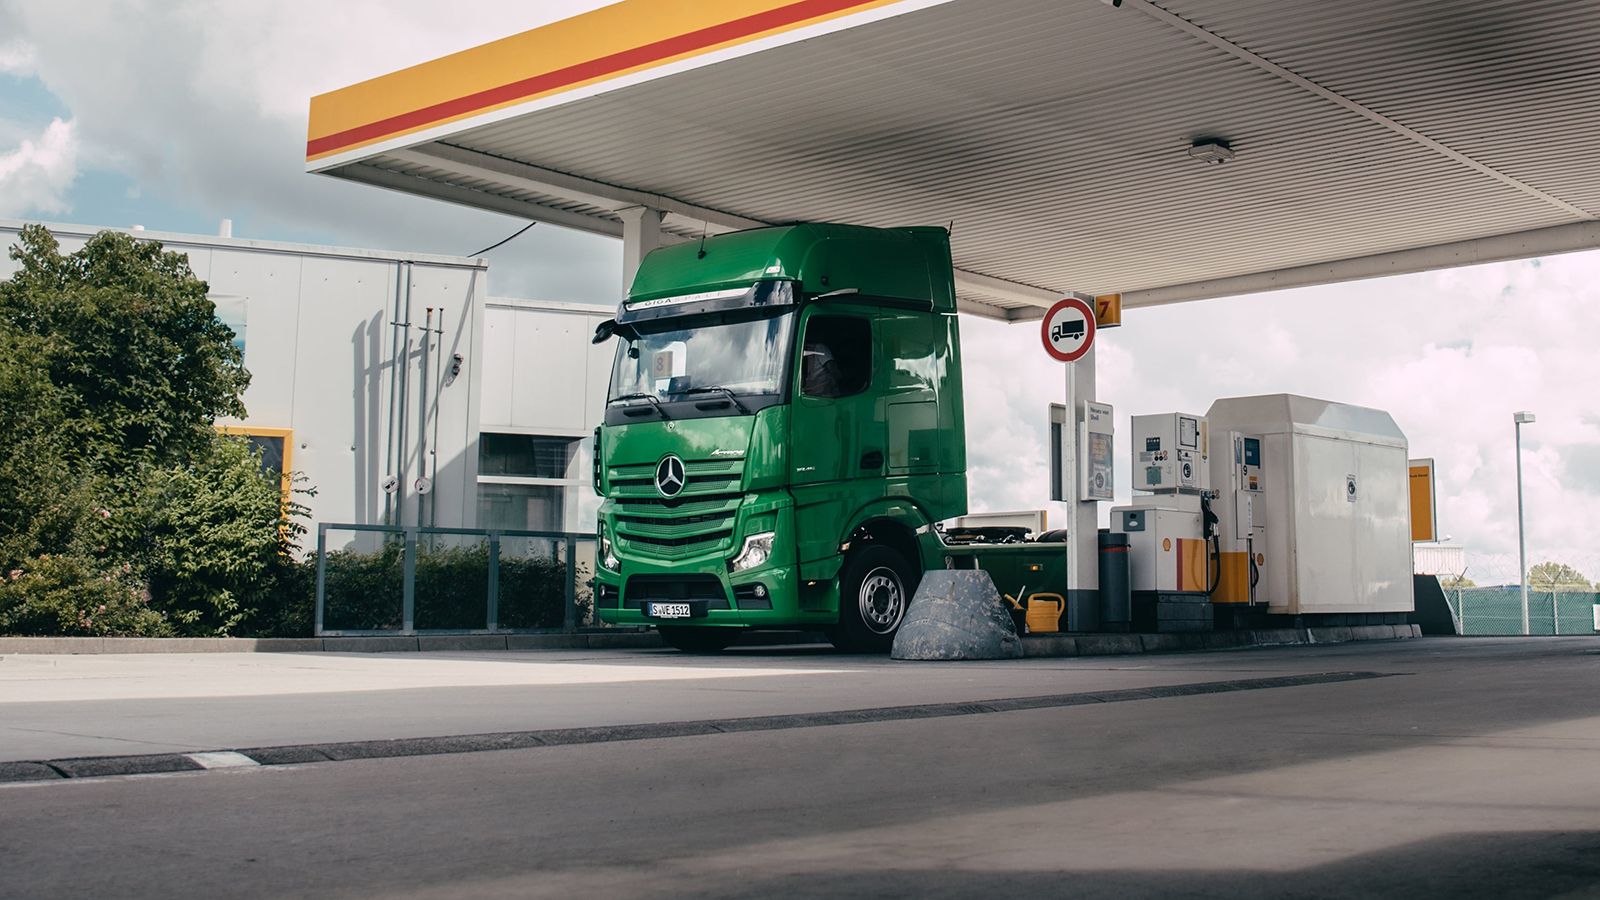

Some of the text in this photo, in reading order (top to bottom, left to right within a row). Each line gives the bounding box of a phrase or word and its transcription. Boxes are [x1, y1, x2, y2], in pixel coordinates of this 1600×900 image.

[1099, 301, 1111, 318] 7
[1243, 465, 1248, 476] 9
[671, 605, 689, 616] 1512
